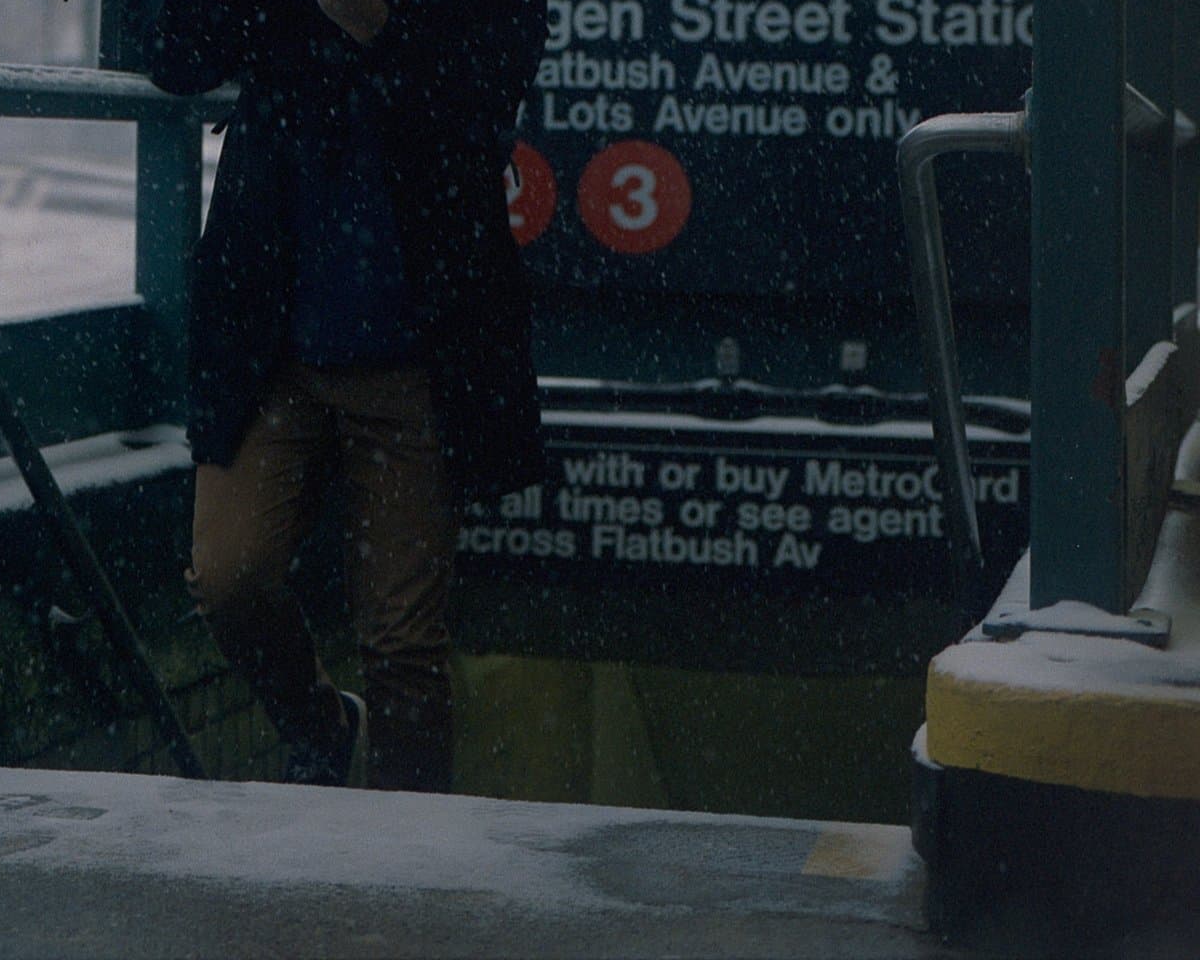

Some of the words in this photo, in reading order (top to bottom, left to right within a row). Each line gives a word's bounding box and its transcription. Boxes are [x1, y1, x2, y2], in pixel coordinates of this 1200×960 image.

[535, 51, 676, 90] atbush
[693, 52, 850, 93] Avenue
[865, 52, 899, 94] &
[543, 93, 634, 132] Lots
[654, 94, 808, 137] Avenue
[608, 163, 658, 229] 3
[563, 452, 645, 487] with
[659, 460, 701, 491] or
[717, 456, 790, 500] buy
[804, 459, 1019, 503] MetroCrd
[500, 484, 543, 520] all
[559, 487, 663, 527] times
[679, 498, 722, 528] or
[737, 502, 812, 531] see
[828, 502, 943, 543] agent
[591, 524, 758, 566] Flatbush
[774, 532, 823, 569] Av
